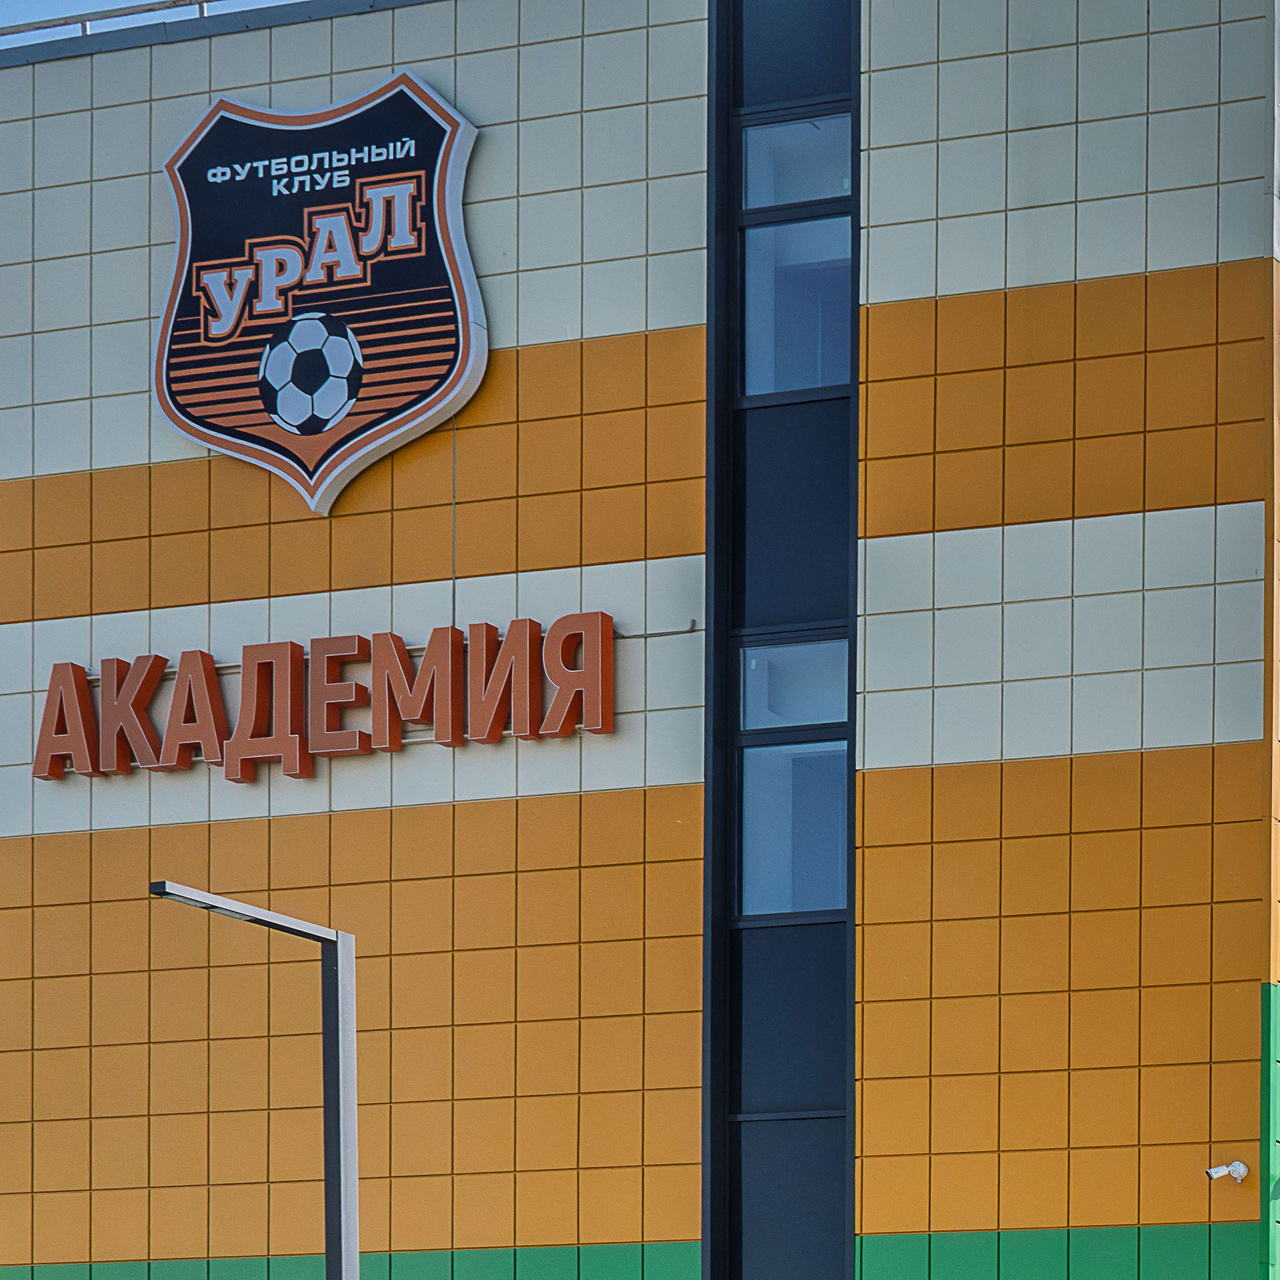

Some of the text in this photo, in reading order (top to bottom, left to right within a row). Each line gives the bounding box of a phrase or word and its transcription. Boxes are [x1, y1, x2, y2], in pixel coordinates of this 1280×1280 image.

[207, 138, 416, 183] ФУТБОЛЬНЫЙ
[271, 169, 351, 197] КЛУБ
[199, 178, 419, 338] УРАЛ
[32, 611, 614, 784] АКАДЕМИЯ
